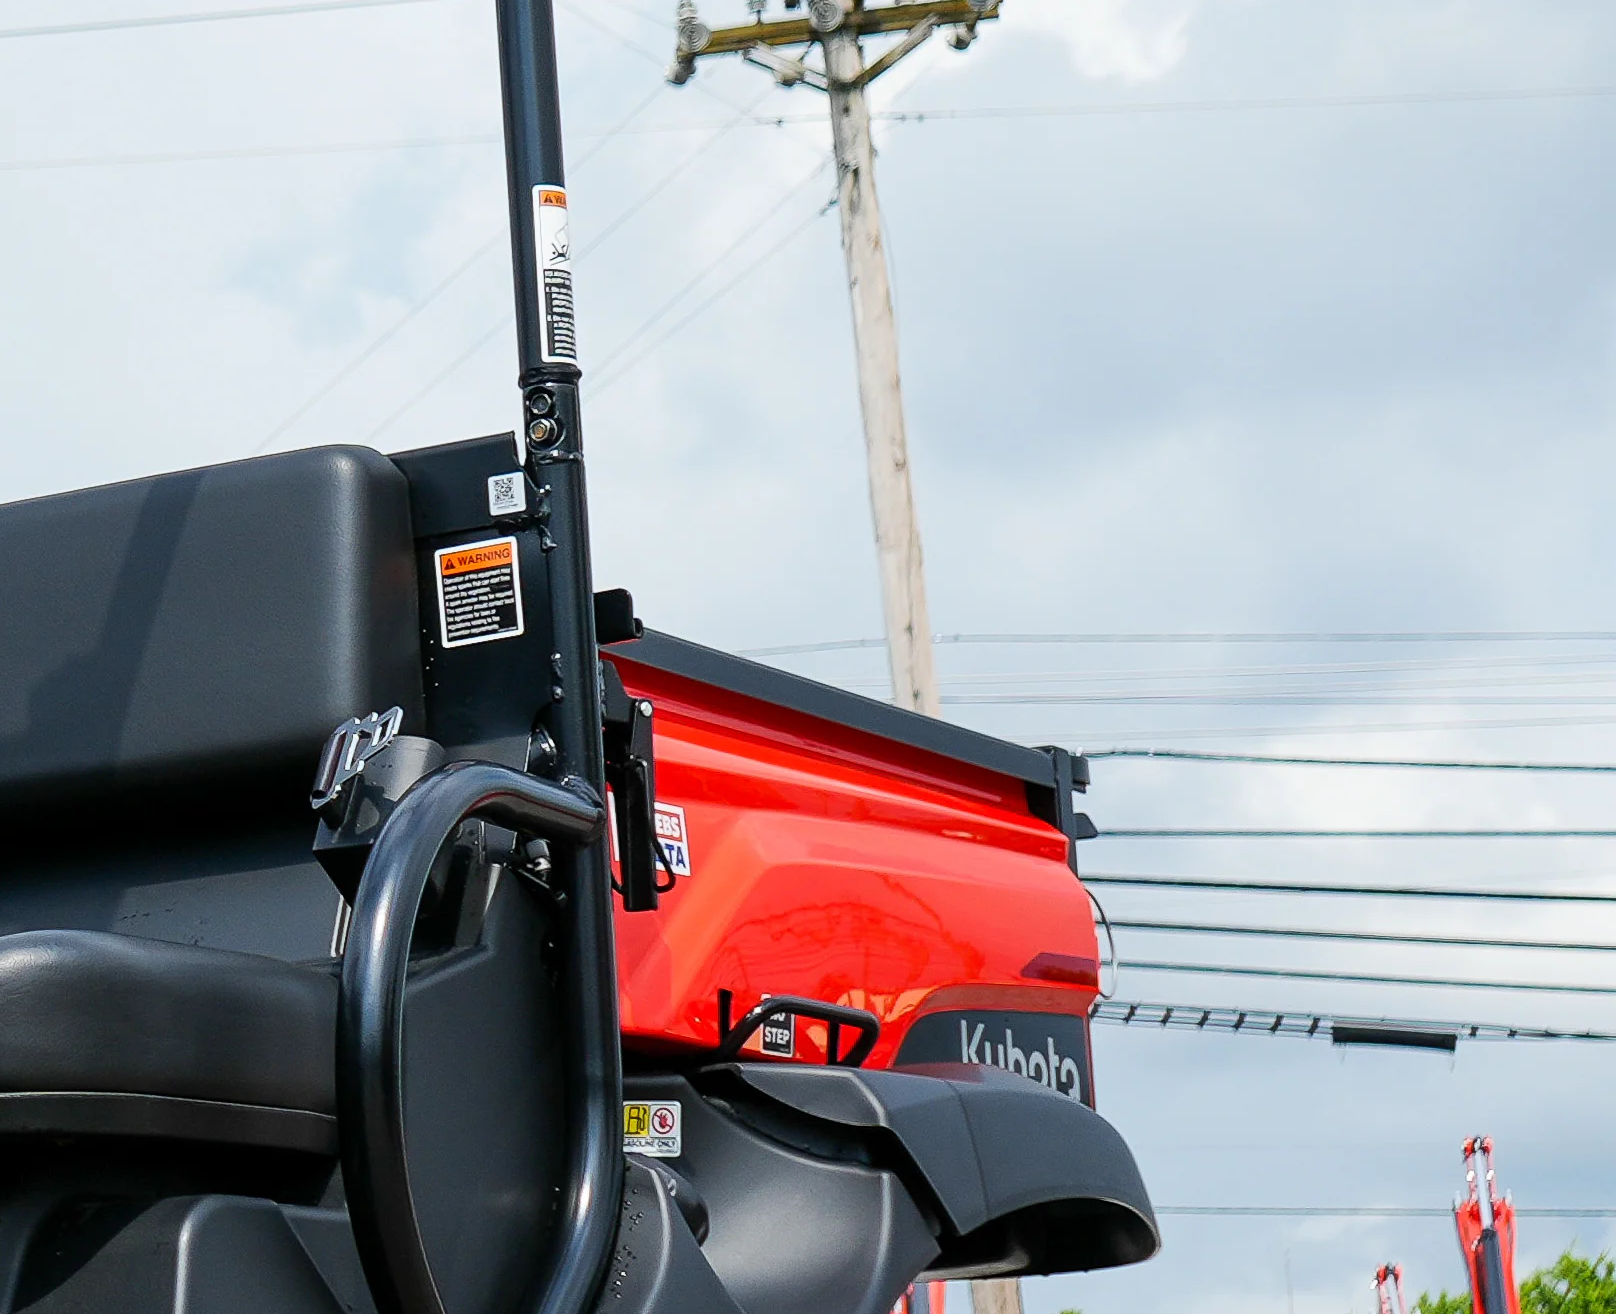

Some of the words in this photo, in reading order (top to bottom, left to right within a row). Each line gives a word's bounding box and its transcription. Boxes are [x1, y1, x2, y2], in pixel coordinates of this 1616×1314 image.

[457, 548, 510, 566] WARNING
[764, 1026, 790, 1045] STEP
[960, 1019, 1081, 1103] Kubota
